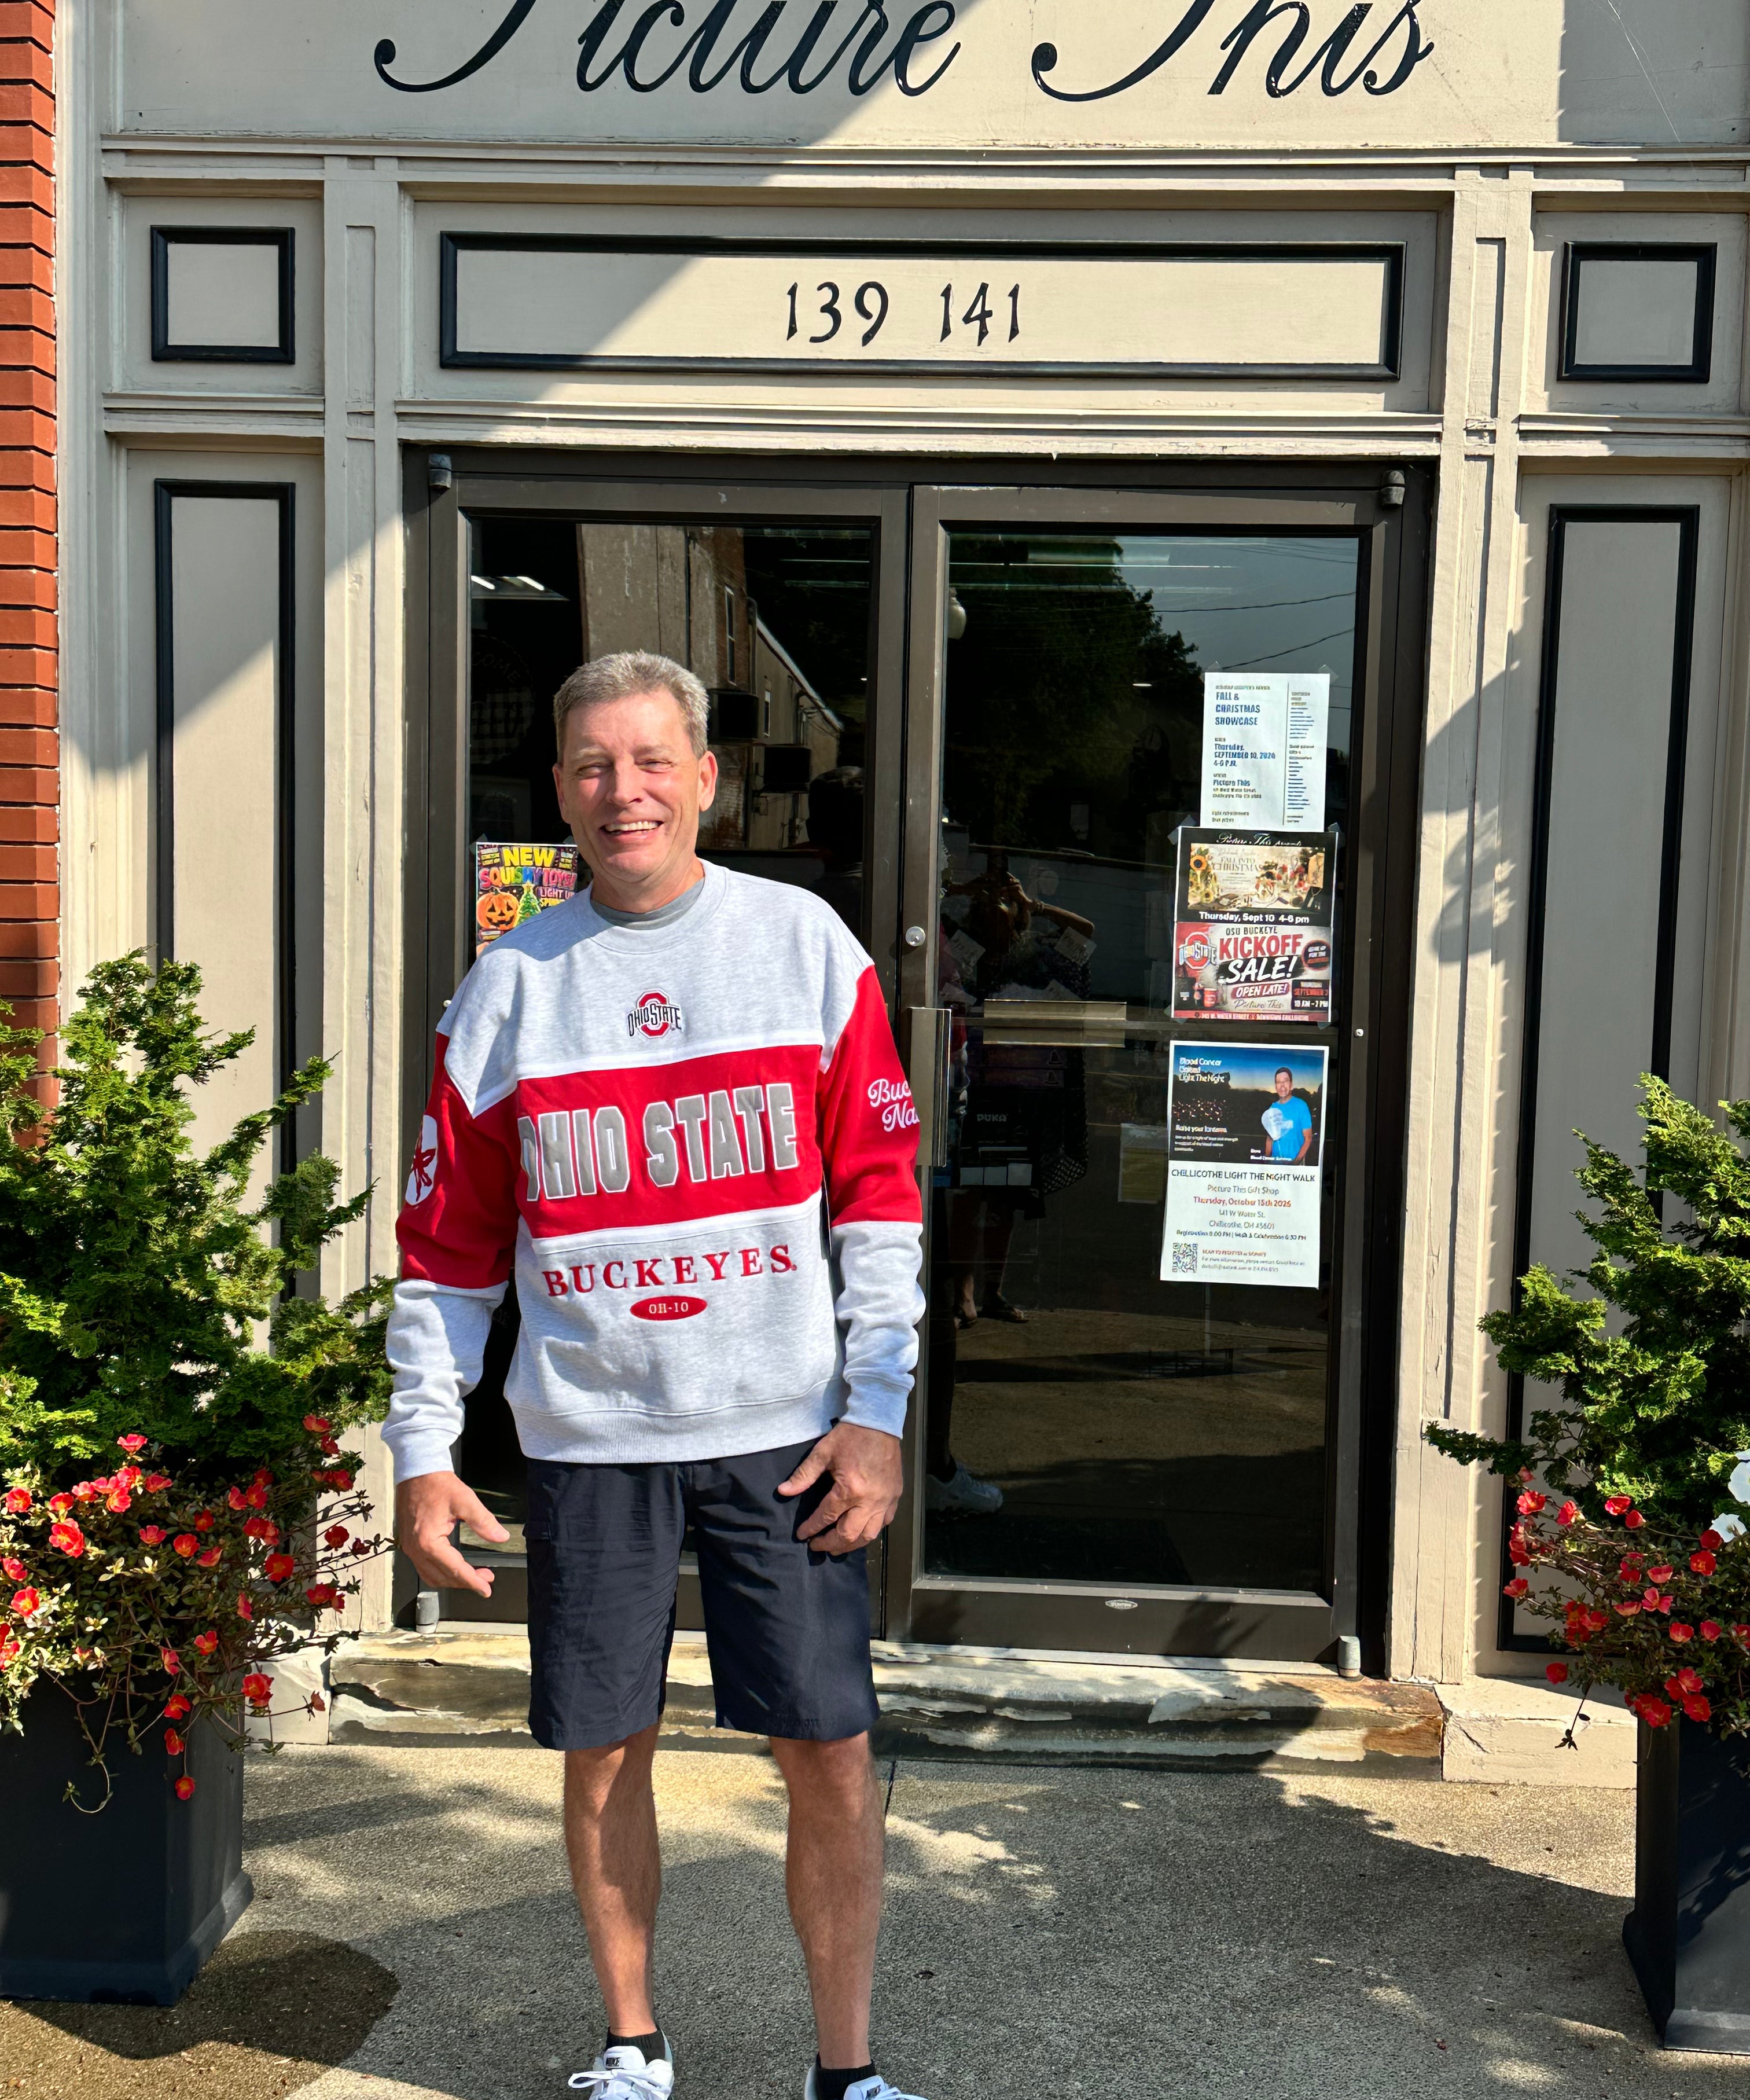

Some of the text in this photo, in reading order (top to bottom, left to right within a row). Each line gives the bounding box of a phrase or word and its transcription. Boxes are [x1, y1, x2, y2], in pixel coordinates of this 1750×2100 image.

[786, 281, 1020, 347] 139 141
[1216, 692, 1232, 700] FALL
[1216, 704, 1260, 713] CHRISTMAS
[1215, 717, 1258, 725] SHOWCASE
[502, 847, 555, 867] NEW
[479, 867, 542, 890] SQUISHY
[540, 887, 564, 897] LIGHT
[1199, 911, 1240, 922] Thursday,
[1242, 913, 1263, 923] Sept
[1226, 926, 1278, 935] OSU BUCKEYE
[1219, 934, 1303, 961] KICKOFF
[1226, 956, 1297, 984] SALE!
[1236, 985, 1262, 998] OPEN
[1262, 983, 1288, 996] LATE!
[628, 1003, 682, 1037] OHIO STATE
[1199, 1058, 1222, 1066] Cancer
[642, 1082, 799, 1188] STATE
[1171, 1169, 1222, 1177] CHILLICOTHE
[1228, 1198, 1256, 1206] October
